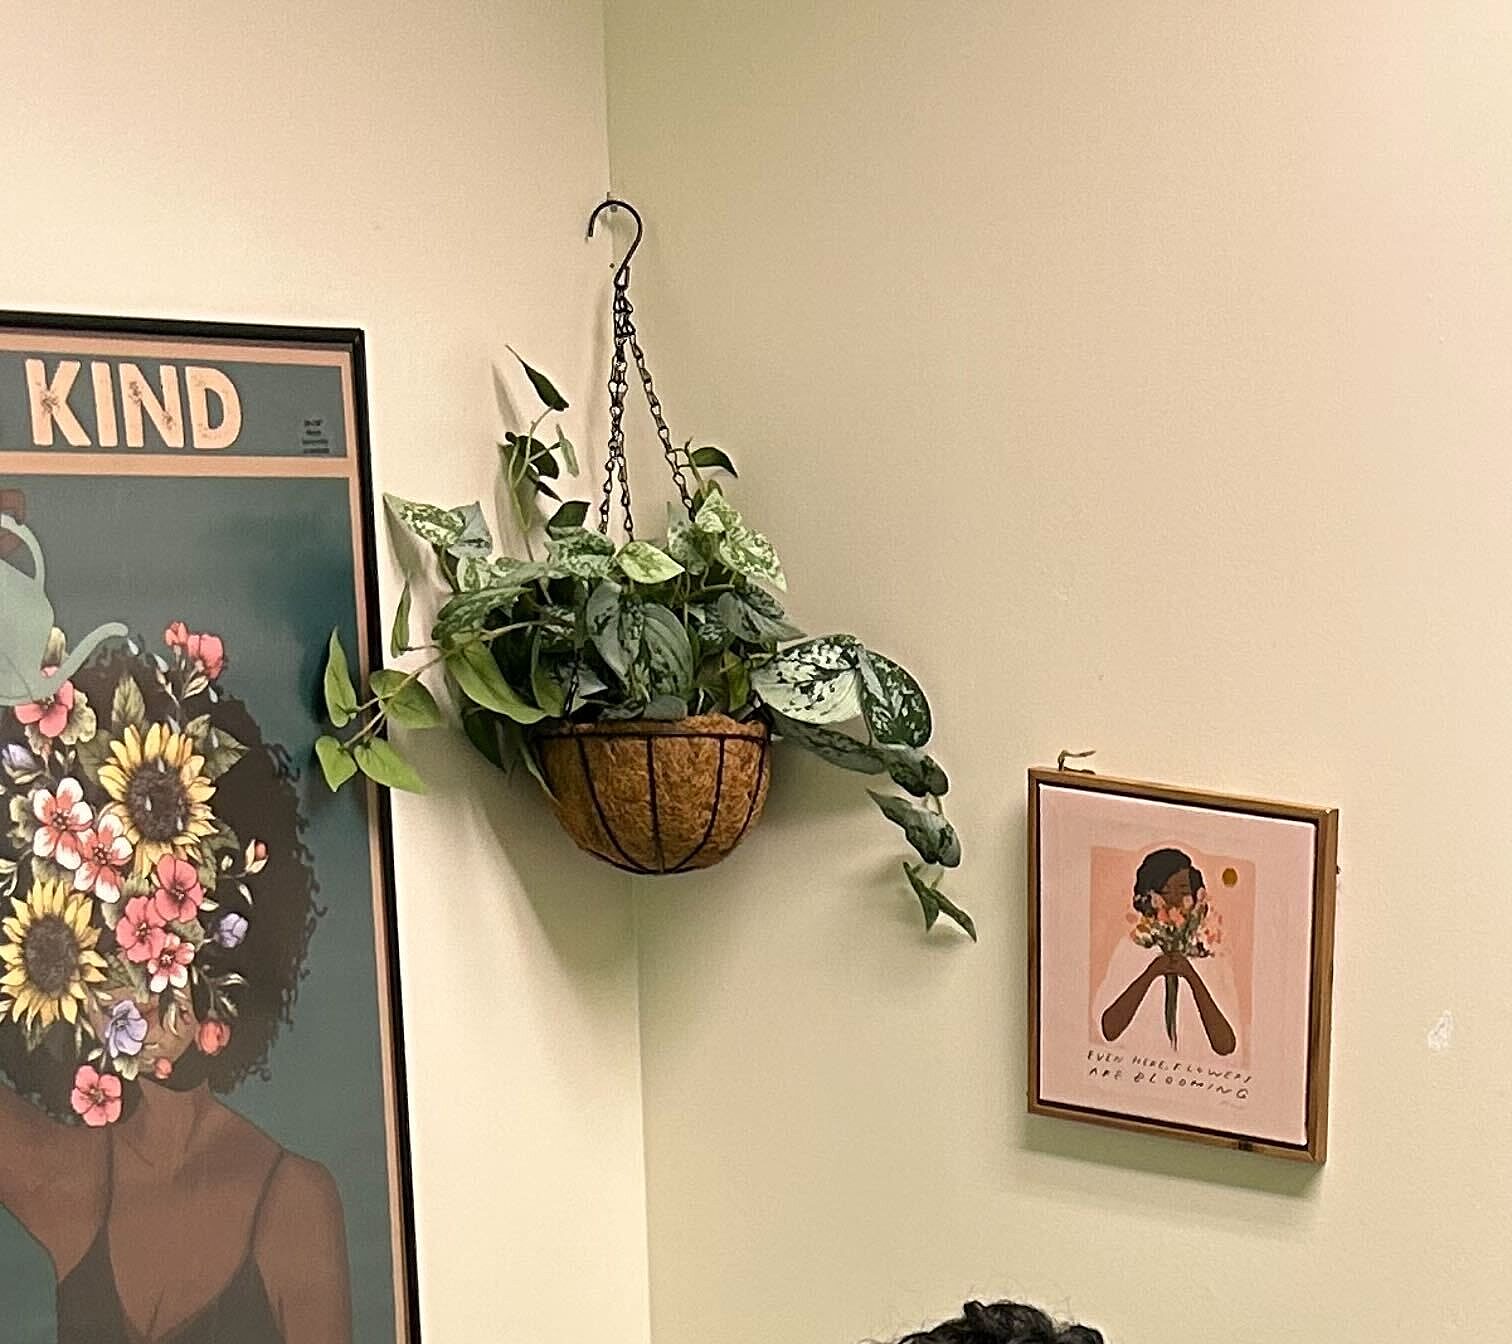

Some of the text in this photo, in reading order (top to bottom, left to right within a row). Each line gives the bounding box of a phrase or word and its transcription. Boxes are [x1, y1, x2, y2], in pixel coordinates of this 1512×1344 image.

[25, 358, 243, 449] KIND
[1087, 1049, 1124, 1064] EVEN
[1089, 1067, 1250, 1100] ARE BLOOMING
